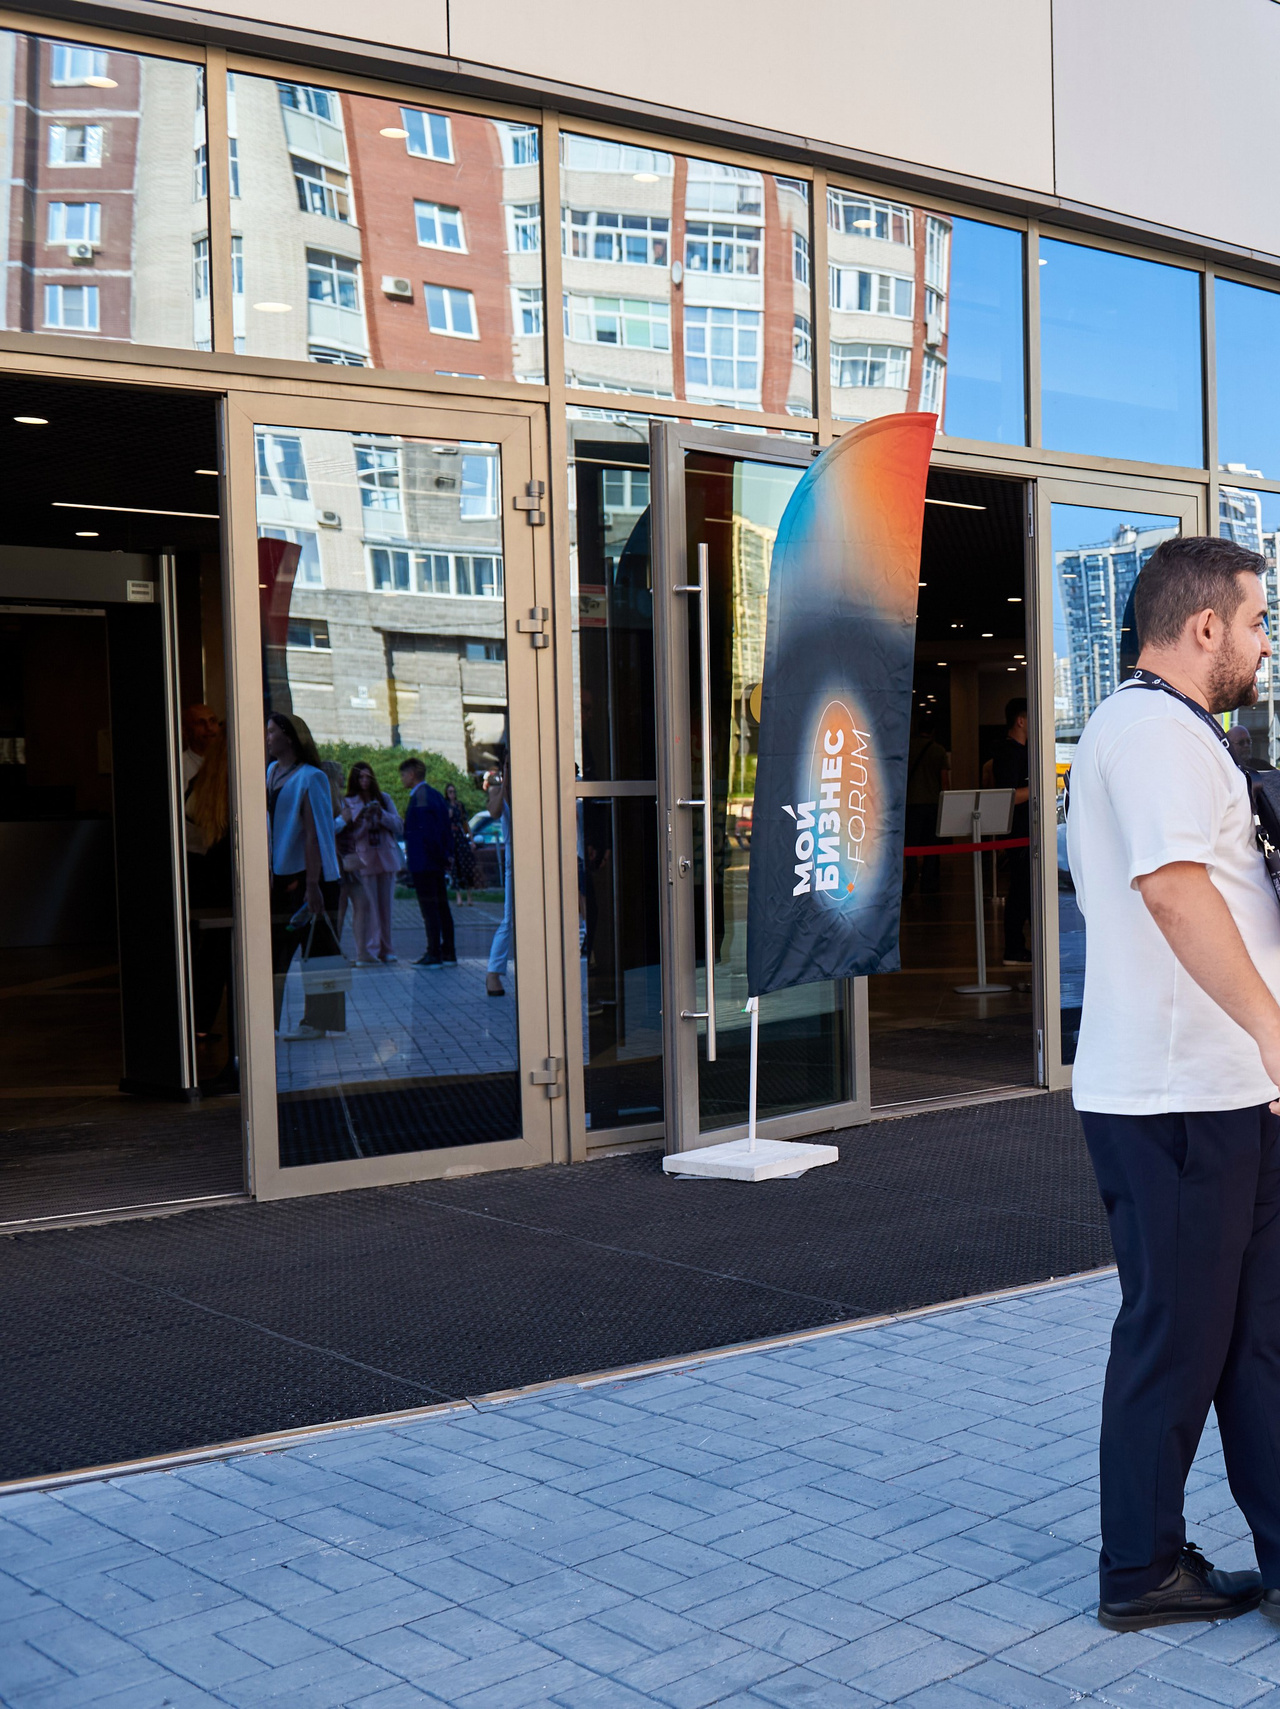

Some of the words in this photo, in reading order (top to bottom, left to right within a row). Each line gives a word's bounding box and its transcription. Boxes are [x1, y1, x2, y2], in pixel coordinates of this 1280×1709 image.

[782, 801, 815, 896] МОЙ
[815, 729, 844, 891] БИЗНЕС
[847, 729, 870, 863] FORUM
